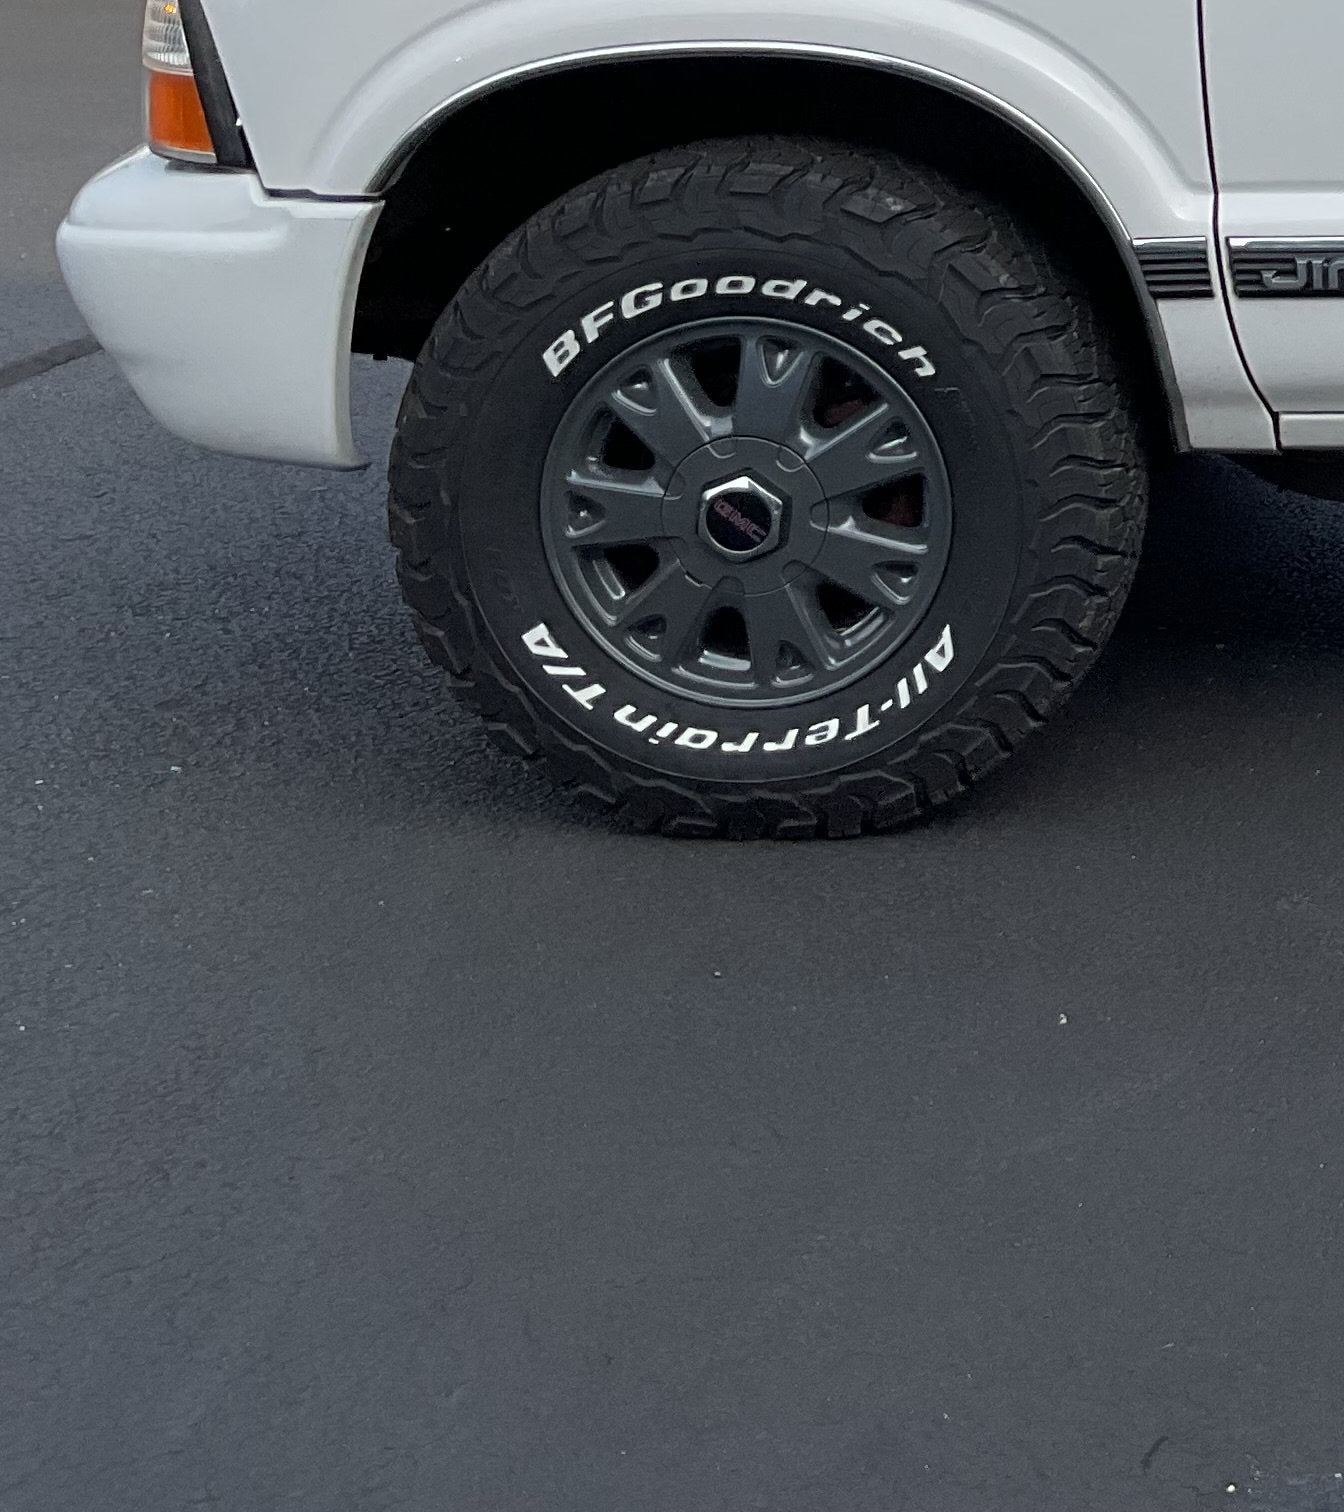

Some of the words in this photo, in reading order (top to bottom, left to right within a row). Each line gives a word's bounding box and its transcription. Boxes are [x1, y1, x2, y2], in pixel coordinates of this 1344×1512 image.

[542, 274, 937, 378] BFGoodrich
[713, 496, 768, 544] GMC
[520, 621, 607, 711] T/A
[613, 623, 956, 754] All-Terrain
